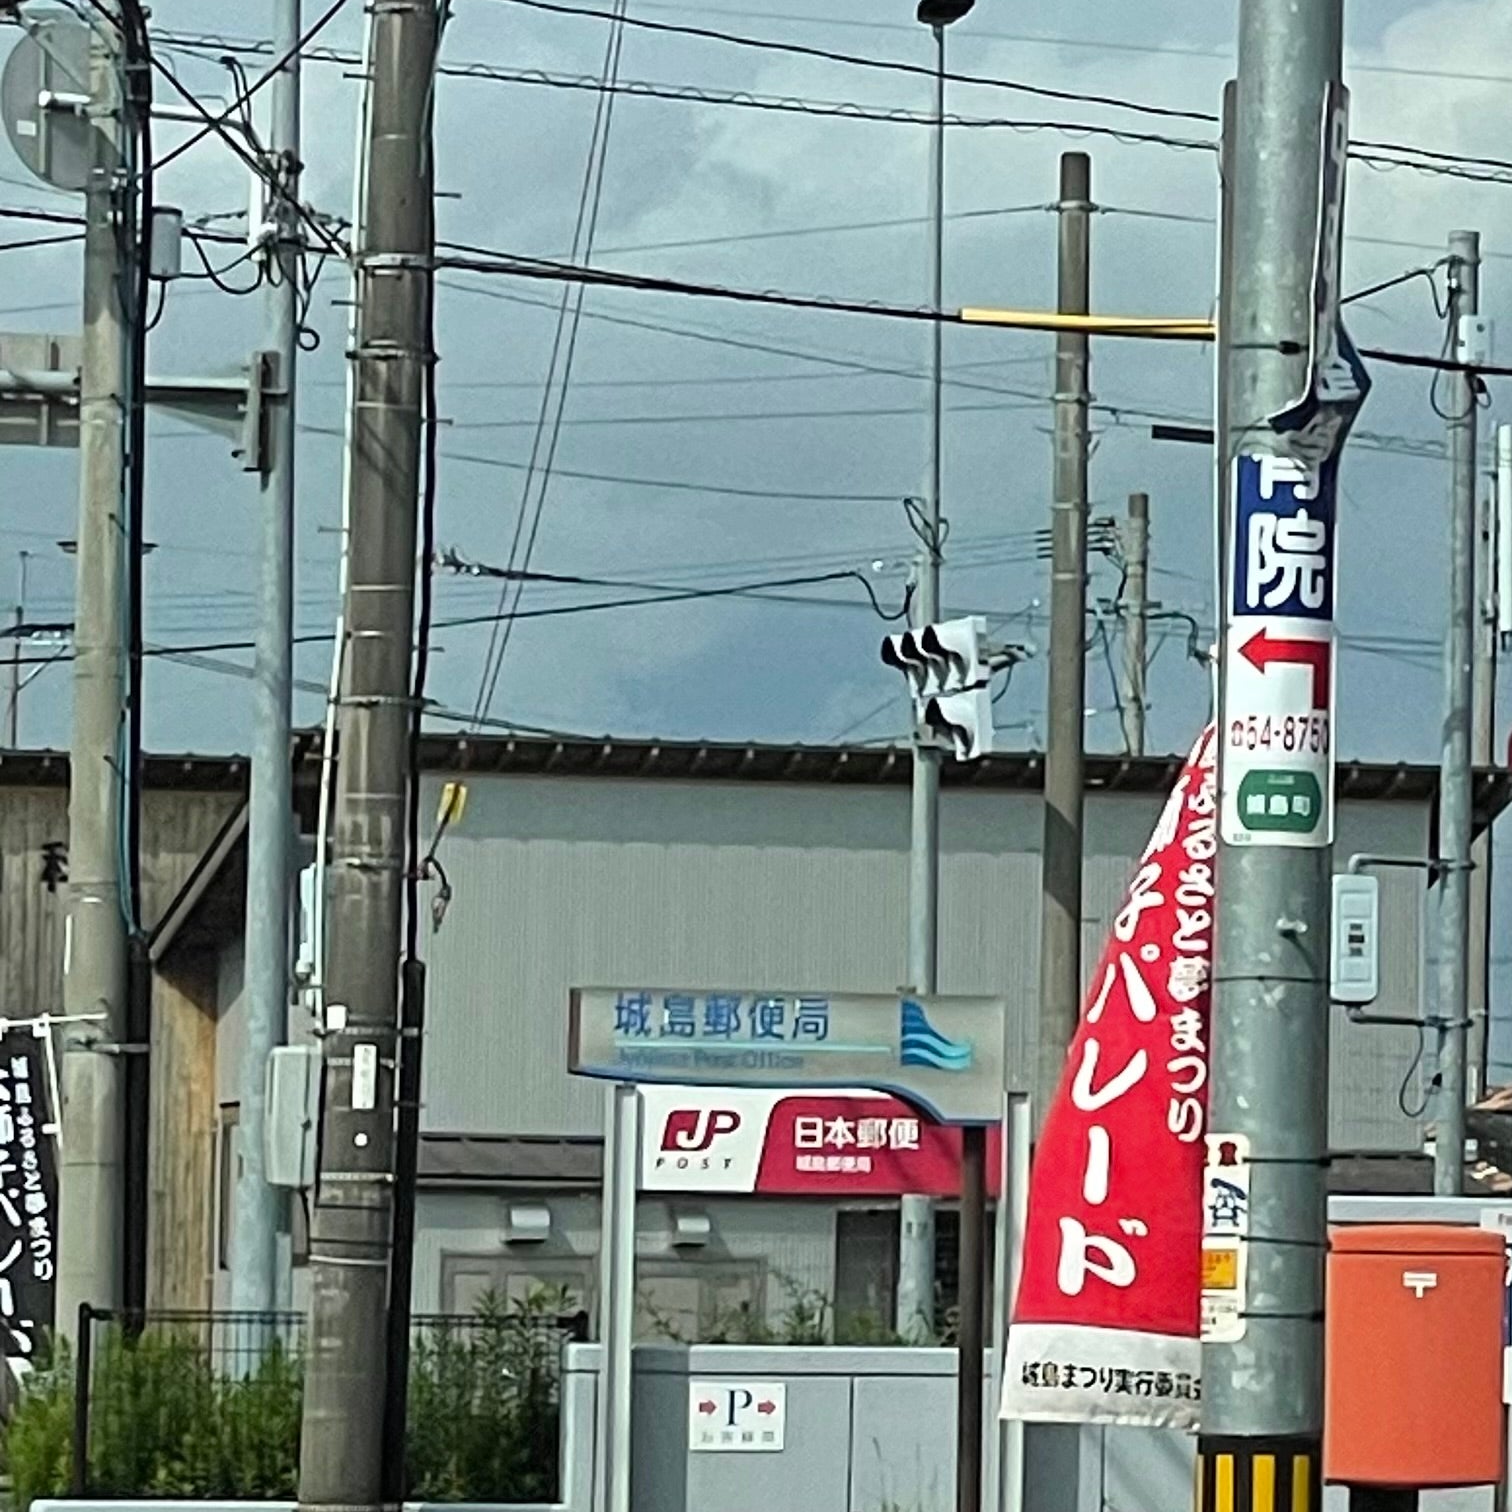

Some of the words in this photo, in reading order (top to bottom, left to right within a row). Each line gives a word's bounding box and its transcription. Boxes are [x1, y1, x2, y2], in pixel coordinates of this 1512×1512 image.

[614, 993, 829, 1042] 城島郵便局
[660, 1109, 742, 1152] JP
[793, 1116, 920, 1151] 日本郵便
[655, 1157, 732, 1170] POST
[727, 1388, 753, 1426] P
